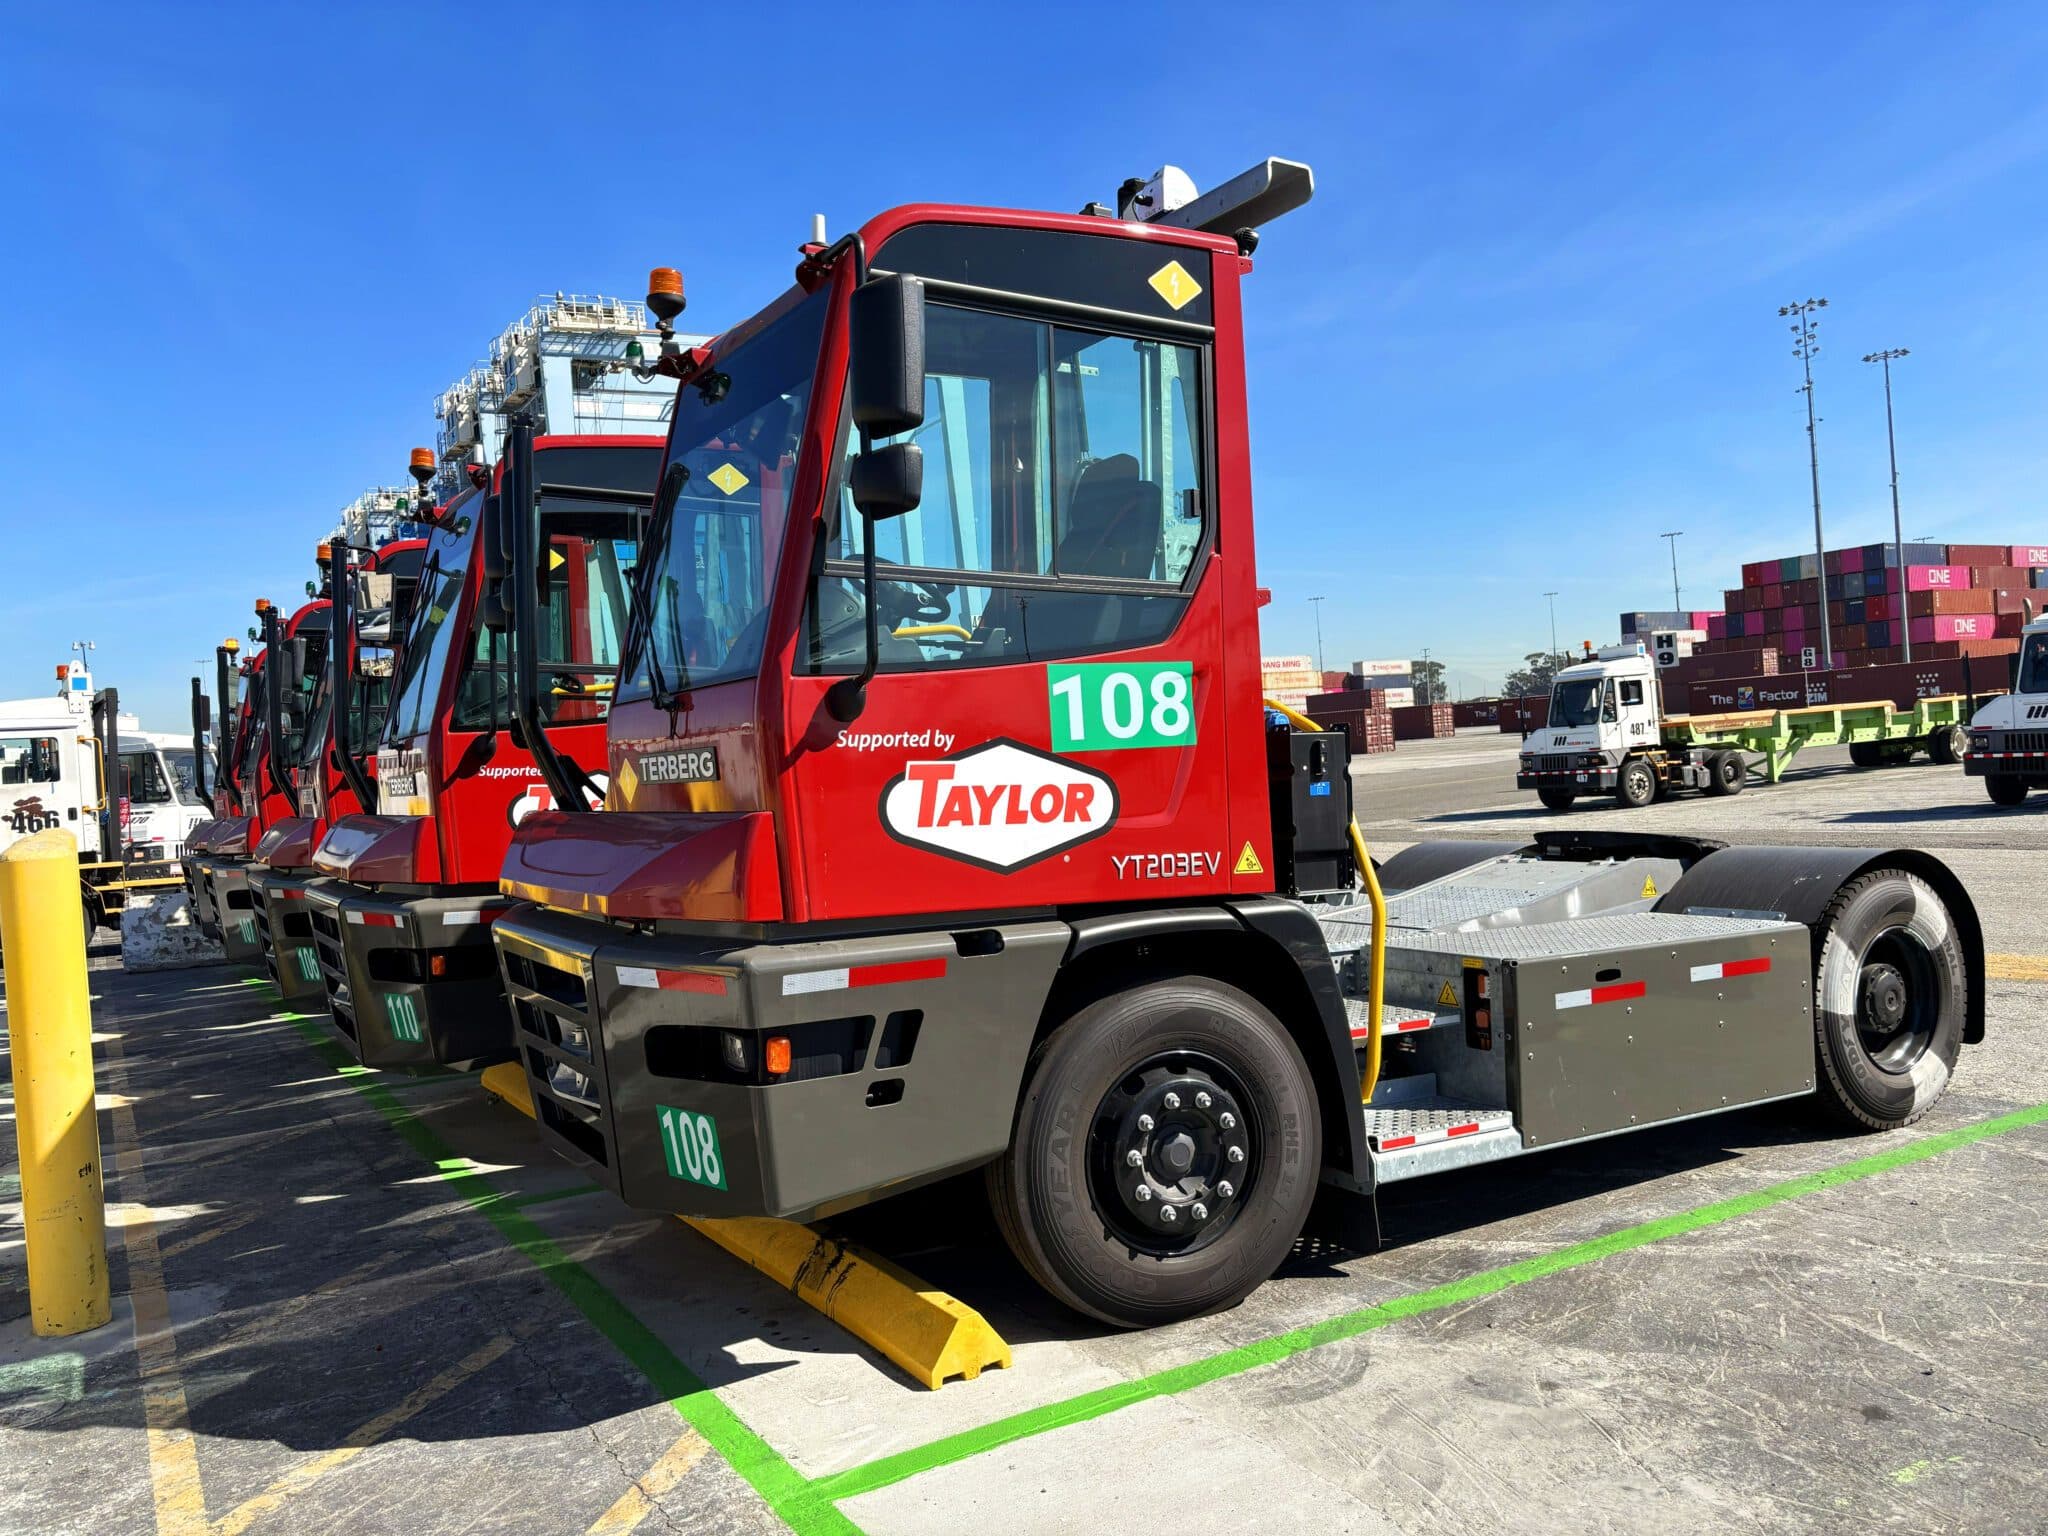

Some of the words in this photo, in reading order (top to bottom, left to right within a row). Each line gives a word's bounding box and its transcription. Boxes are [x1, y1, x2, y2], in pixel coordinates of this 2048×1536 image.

[2028, 549, 2048, 562] ONE
[1928, 569, 1951, 584] ONE
[1954, 618, 1977, 633] ONE
[1656, 634, 1674, 649] H
[1658, 651, 1675, 665] 9
[1803, 648, 1813, 658] G
[1262, 661, 1281, 669] YANG
[1282, 660, 1301, 668] MING
[1803, 658, 1813, 667] 8
[1051, 670, 1191, 741] 108
[1709, 694, 1734, 706] The
[1759, 690, 1800, 702] Factor
[1806, 692, 1828, 703] ZIM
[1629, 722, 1645, 736] 487
[836, 729, 932, 753] Supported
[934, 729, 955, 752] by
[639, 751, 715, 782] TERBERG
[388, 776, 414, 795] TERBERG
[907, 763, 1096, 829] TAYLOR
[10, 809, 60, 834] 466
[1111, 851, 1223, 880] YT203EV
[240, 917, 256, 944] 107
[297, 946, 321, 981] 106
[387, 995, 420, 1041] 110
[662, 1109, 721, 1186] 108
